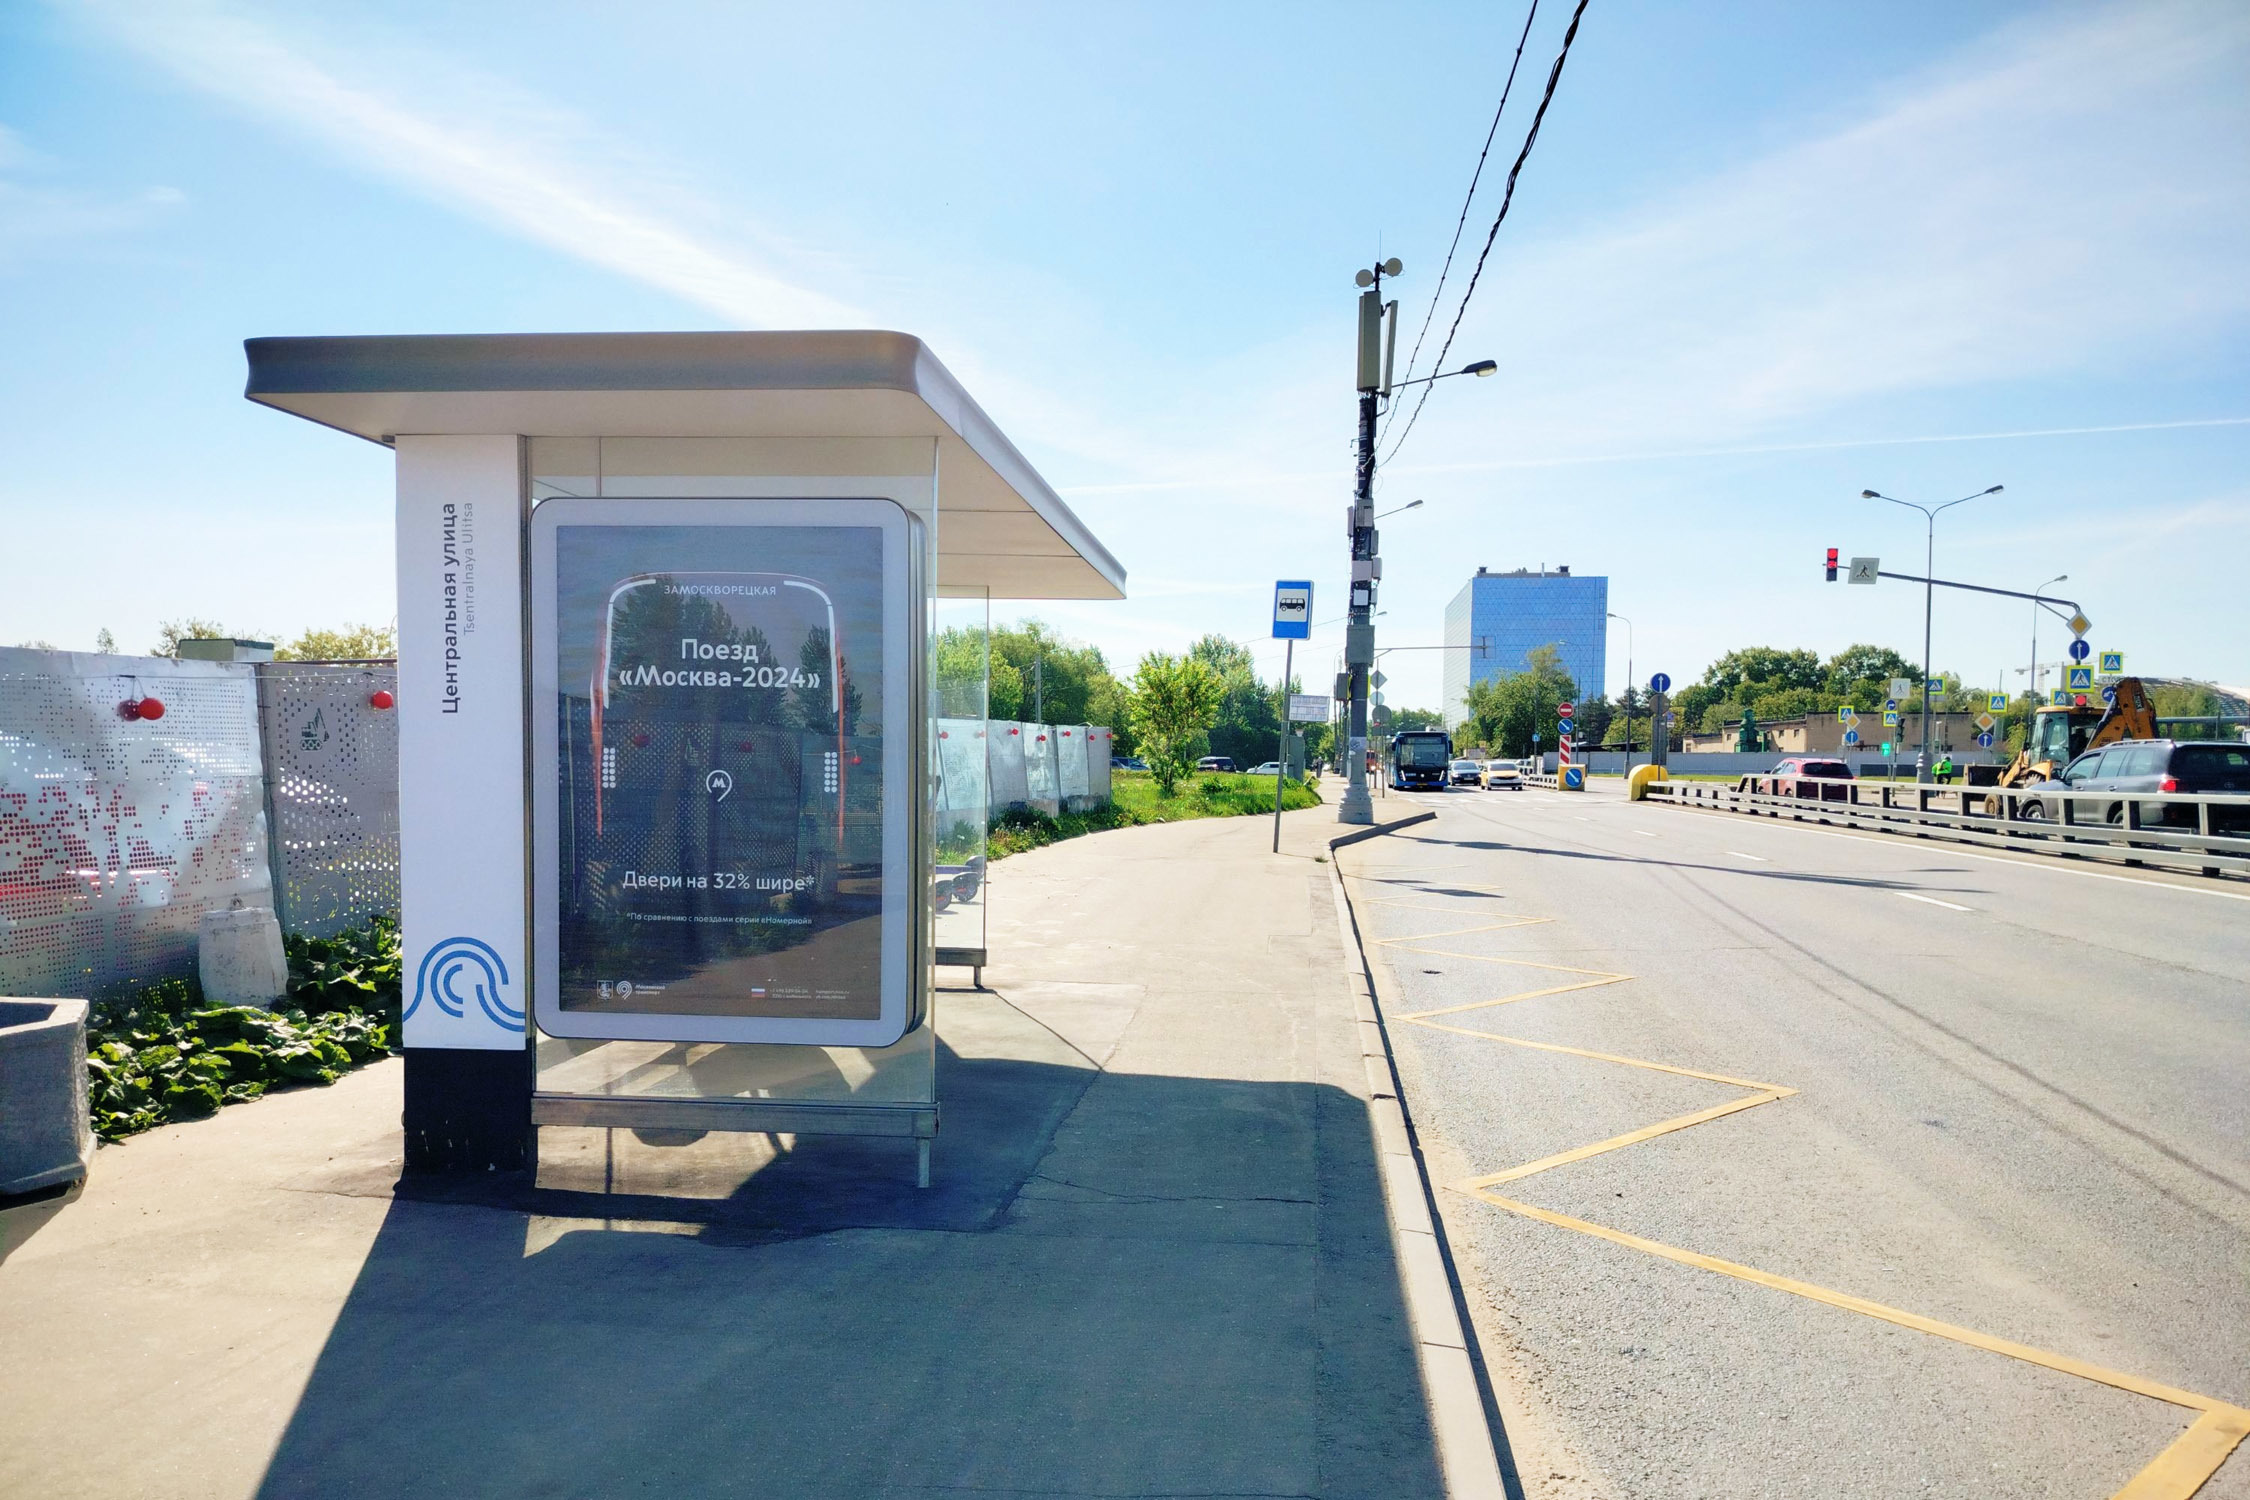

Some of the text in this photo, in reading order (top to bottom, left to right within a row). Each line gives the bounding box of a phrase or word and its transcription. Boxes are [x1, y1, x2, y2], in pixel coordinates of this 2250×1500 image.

[462, 502, 476, 636] Tsentralnaya Ulitsa
[664, 585, 776, 596] ЗАМОСКВОРЕЦКАЯ
[442, 503, 461, 713] Центральная улица
[681, 638, 759, 664] Поезд
[619, 664, 821, 689] «Москва-2024»
[622, 871, 682, 891] Двери
[686, 877, 708, 889] на
[713, 873, 750, 890] 32%
[643, 914, 687, 923] сравнению
[693, 916, 734, 924] поездами
[734, 917, 760, 925] серии
